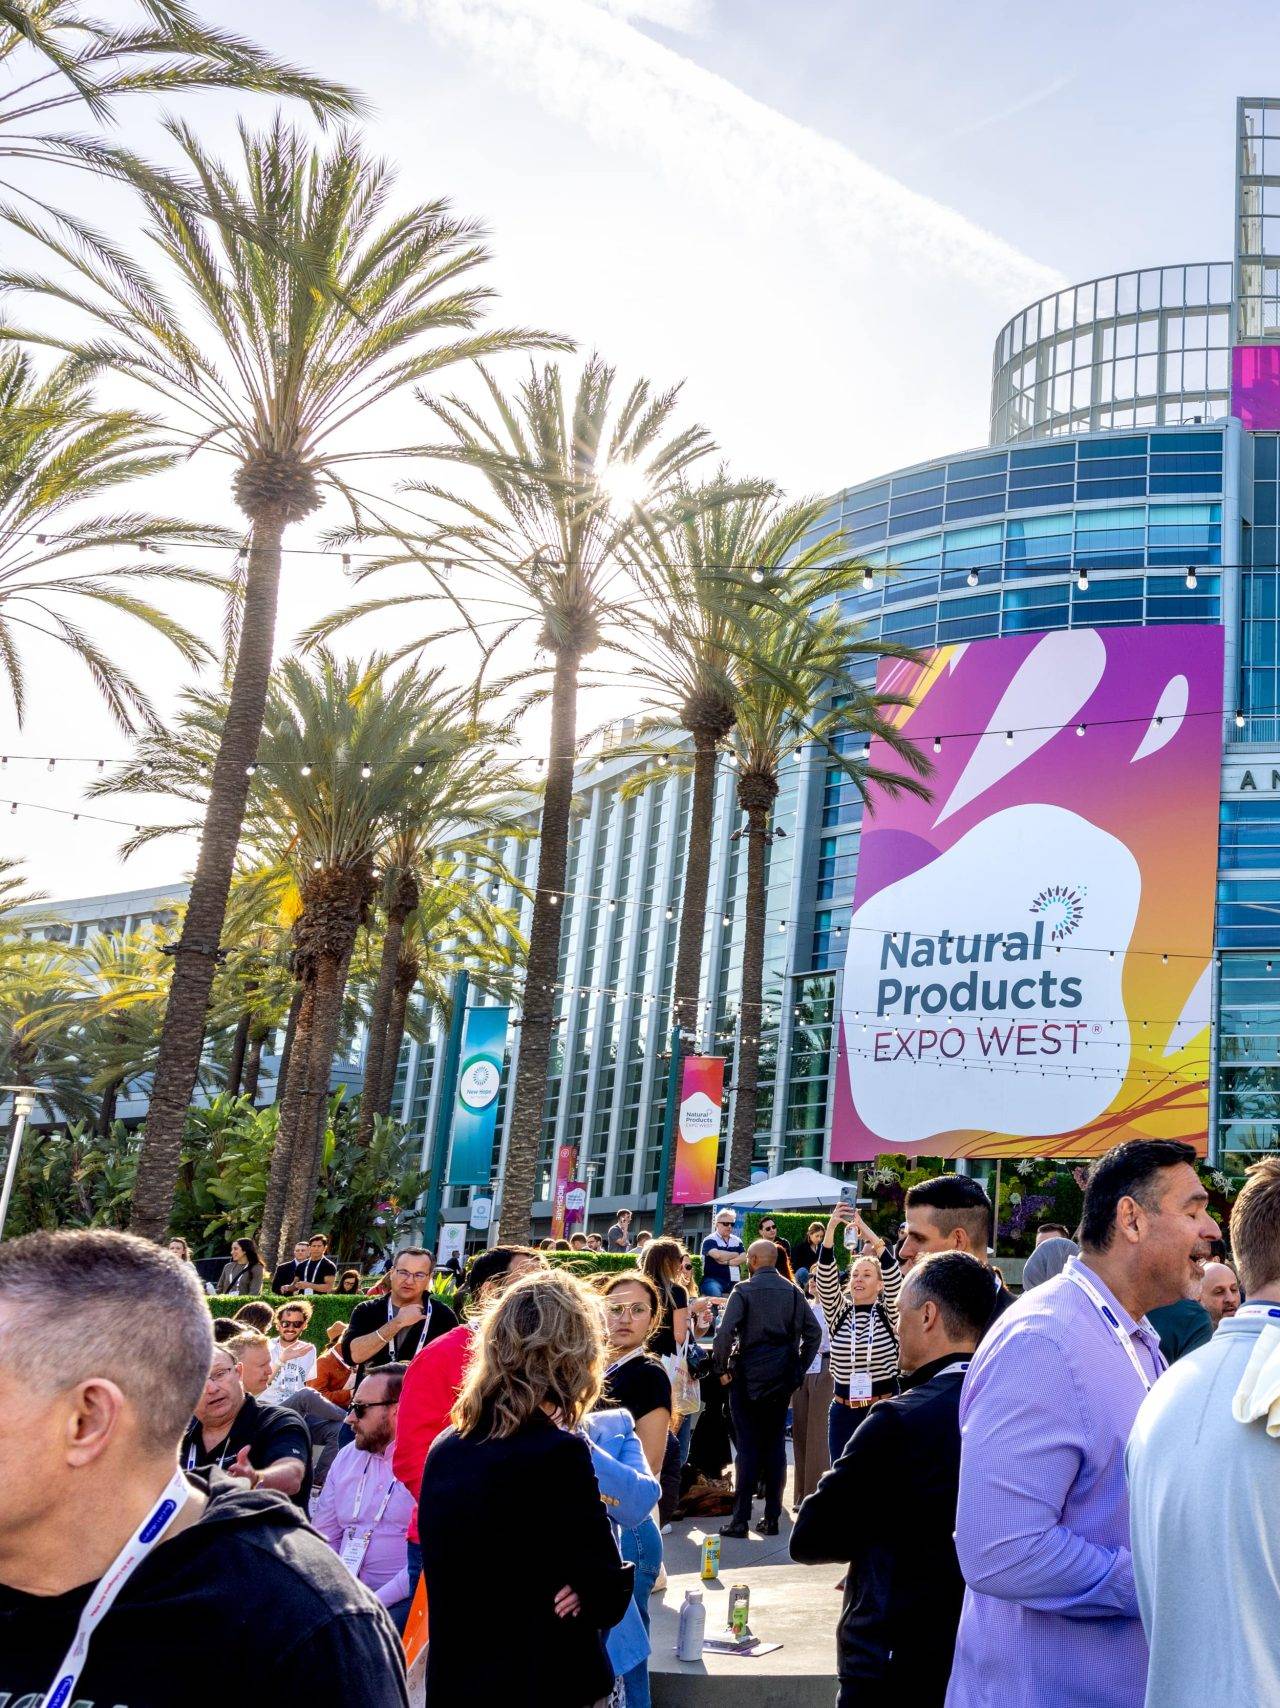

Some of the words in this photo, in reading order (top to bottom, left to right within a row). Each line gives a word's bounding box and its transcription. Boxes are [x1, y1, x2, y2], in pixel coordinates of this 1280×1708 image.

[880, 920, 1045, 970] Natural
[876, 970, 1083, 1017] Products
[873, 1027, 966, 1062] EXPO
